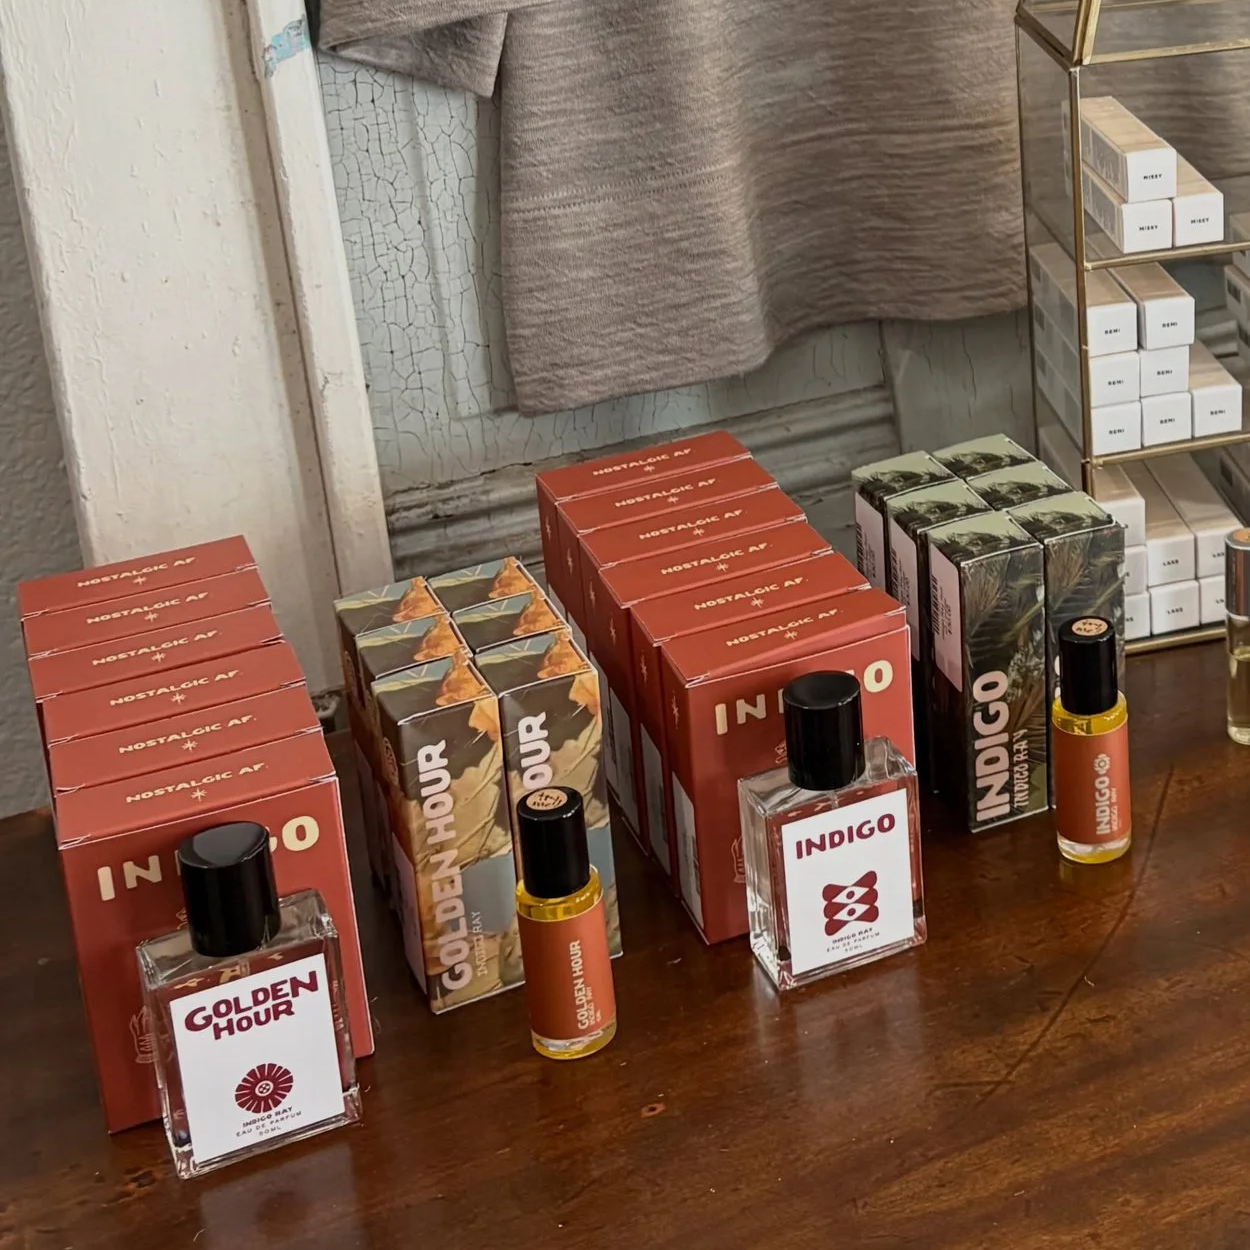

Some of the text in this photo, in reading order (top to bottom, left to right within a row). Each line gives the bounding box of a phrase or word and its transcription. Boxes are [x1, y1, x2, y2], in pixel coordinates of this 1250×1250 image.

[593, 453, 669, 476] NOSTALGIC
[615, 482, 693, 507] NOSTALGIC
[639, 515, 719, 539] NOSTALGIC
[77, 562, 168, 588] NOSTALGIC
[661, 549, 744, 575] NOSTALGIC
[87, 598, 179, 624] NOSTALGIC
[694, 584, 779, 610] NOSTALGIC
[726, 615, 813, 647] NOSTALGIC
[92, 636, 189, 666] NOSTALGIC
[110, 677, 209, 706] NOSTALGIC
[119, 723, 222, 754] NOSTALGIC
[517, 711, 553, 792] OUR
[972, 670, 1010, 822] INDIGO
[1012, 729, 1029, 808] INDIGO RAY
[126, 773, 234, 803] NOSTALGIC
[1094, 776, 1111, 835] INDIGO
[795, 813, 896, 860] INDIGO
[417, 739, 471, 991] GOLDEN HOUR
[569, 940, 589, 1029] GOLDEN HOUR
[184, 970, 319, 1033] GOLDEN
[213, 998, 295, 1040] HOUR
[236, 1129, 252, 1137] EAU
[270, 1111, 301, 1124] PARFUM
[243, 1106, 292, 1128] INDIGO RAY
